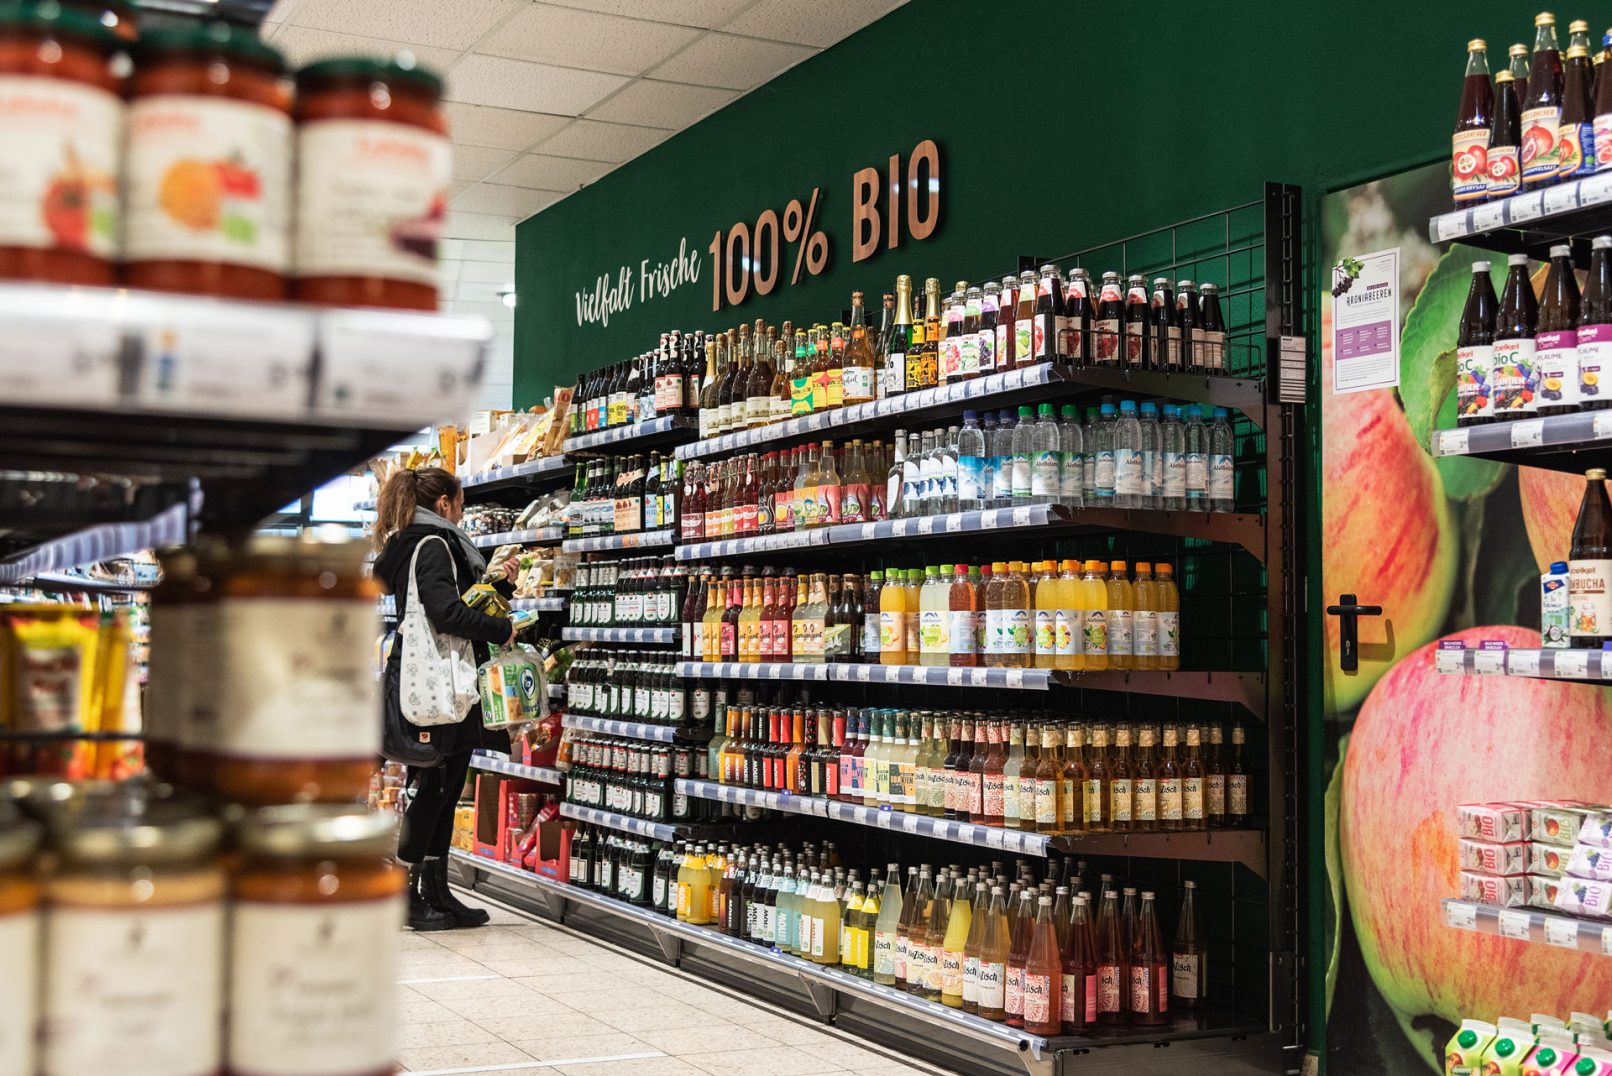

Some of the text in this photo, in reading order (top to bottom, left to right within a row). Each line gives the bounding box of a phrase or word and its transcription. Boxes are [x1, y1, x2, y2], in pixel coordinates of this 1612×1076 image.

[575, 139, 940, 327] Vielfalt Frische 100% BIO
